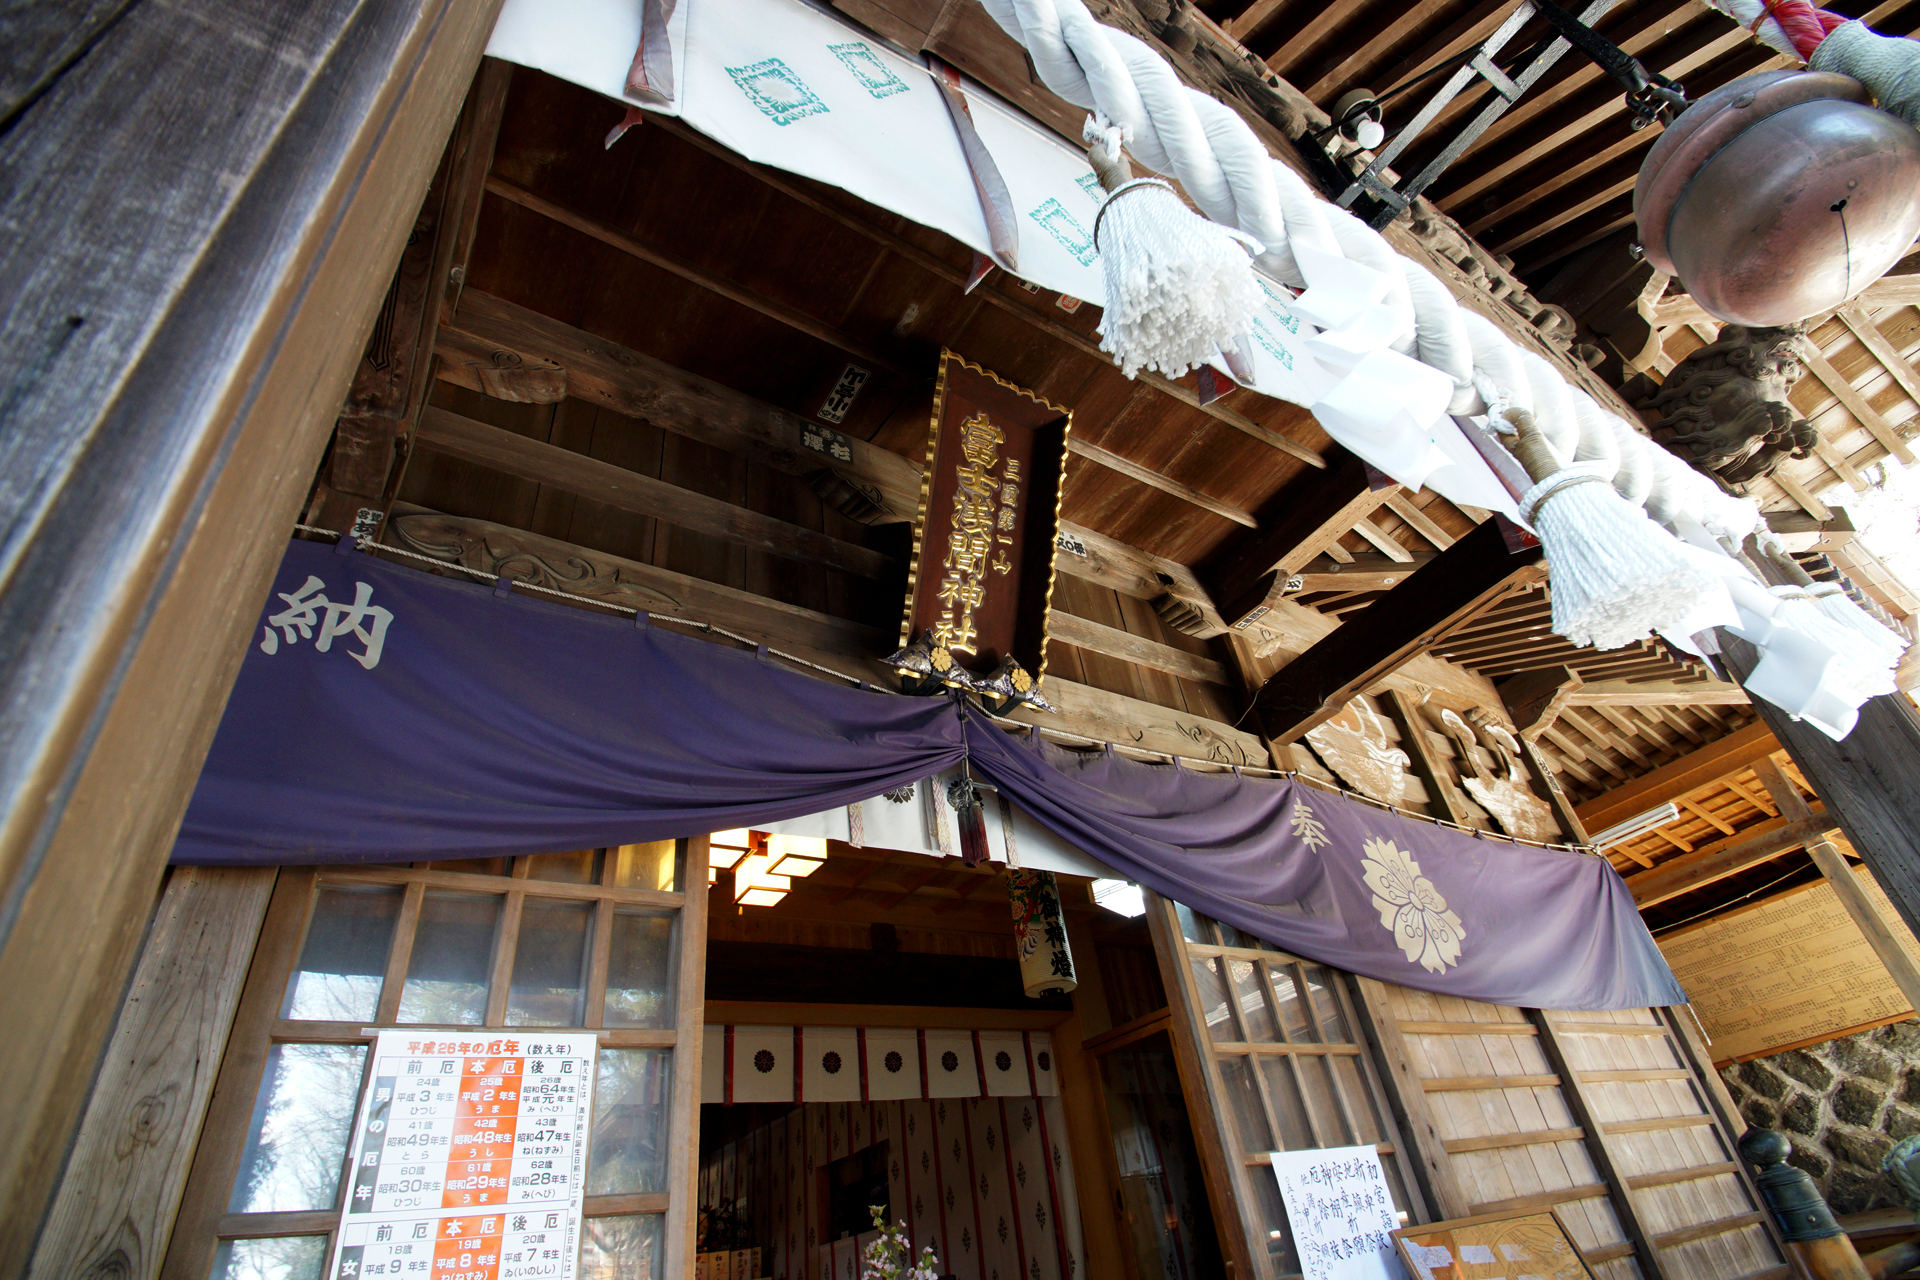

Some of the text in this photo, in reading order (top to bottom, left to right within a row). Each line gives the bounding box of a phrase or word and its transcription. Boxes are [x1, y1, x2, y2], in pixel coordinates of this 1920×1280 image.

[935, 413, 1006, 656] 富士浅間神社
[260, 575, 394, 670] 納
[407, 1039, 572, 1055] 平成26年の厄年 (数え年)
[416, 1078, 440, 1087] 24歳
[480, 1077, 503, 1086] 25歳
[540, 1076, 561, 1084] 26歳
[523, 1084, 576, 1094] 昭和64年生
[410, 1106, 437, 1115] ひつじ
[408, 1120, 433, 1130] 41歳
[473, 1119, 498, 1128] 42歳
[535, 1118, 557, 1127] 43歳
[387, 1133, 448, 1147] 昭和49年生
[453, 1131, 513, 1144] 昭和48年生
[517, 1130, 571, 1143] 昭和47年生
[355, 1087, 391, 1201] 男の厄年
[467, 1163, 491, 1172] 61歳
[531, 1160, 553, 1169] 62歳
[400, 1165, 425, 1175] 60歳
[446, 1176, 507, 1190] 昭和29年生
[512, 1173, 568, 1186] 昭和28年生
[378, 1180, 441, 1193] 昭和30年生
[393, 1197, 422, 1207] ひつじ
[523, 1234, 546, 1244] 20歳
[457, 1240, 482, 1249] 19歳
[388, 1245, 413, 1255] 18歳
